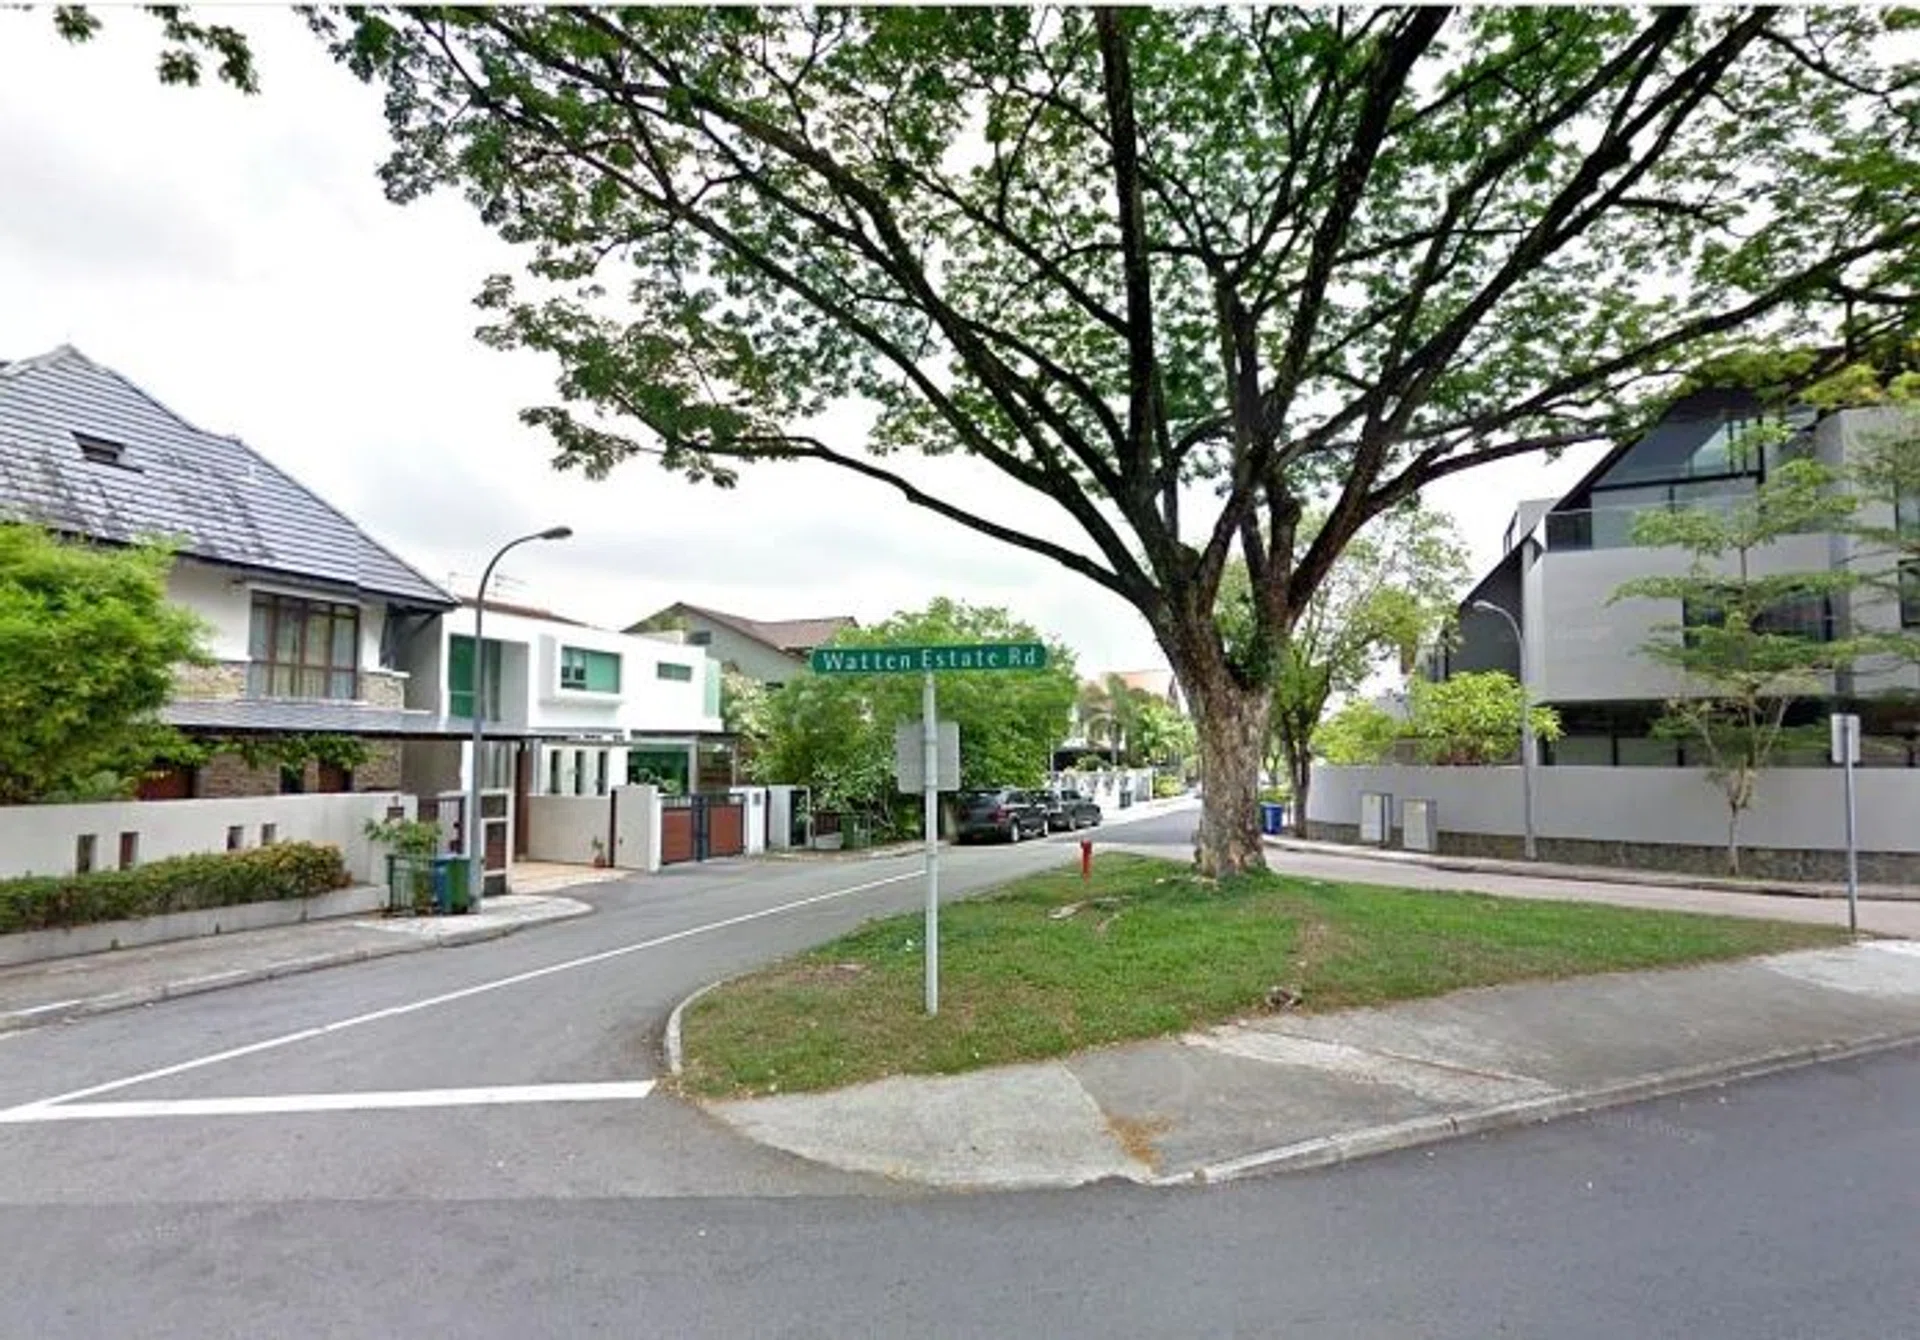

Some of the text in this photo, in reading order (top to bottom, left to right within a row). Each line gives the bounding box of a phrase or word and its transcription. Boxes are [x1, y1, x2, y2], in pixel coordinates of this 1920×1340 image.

[823, 647, 1036, 670] Watten Estate Rd
